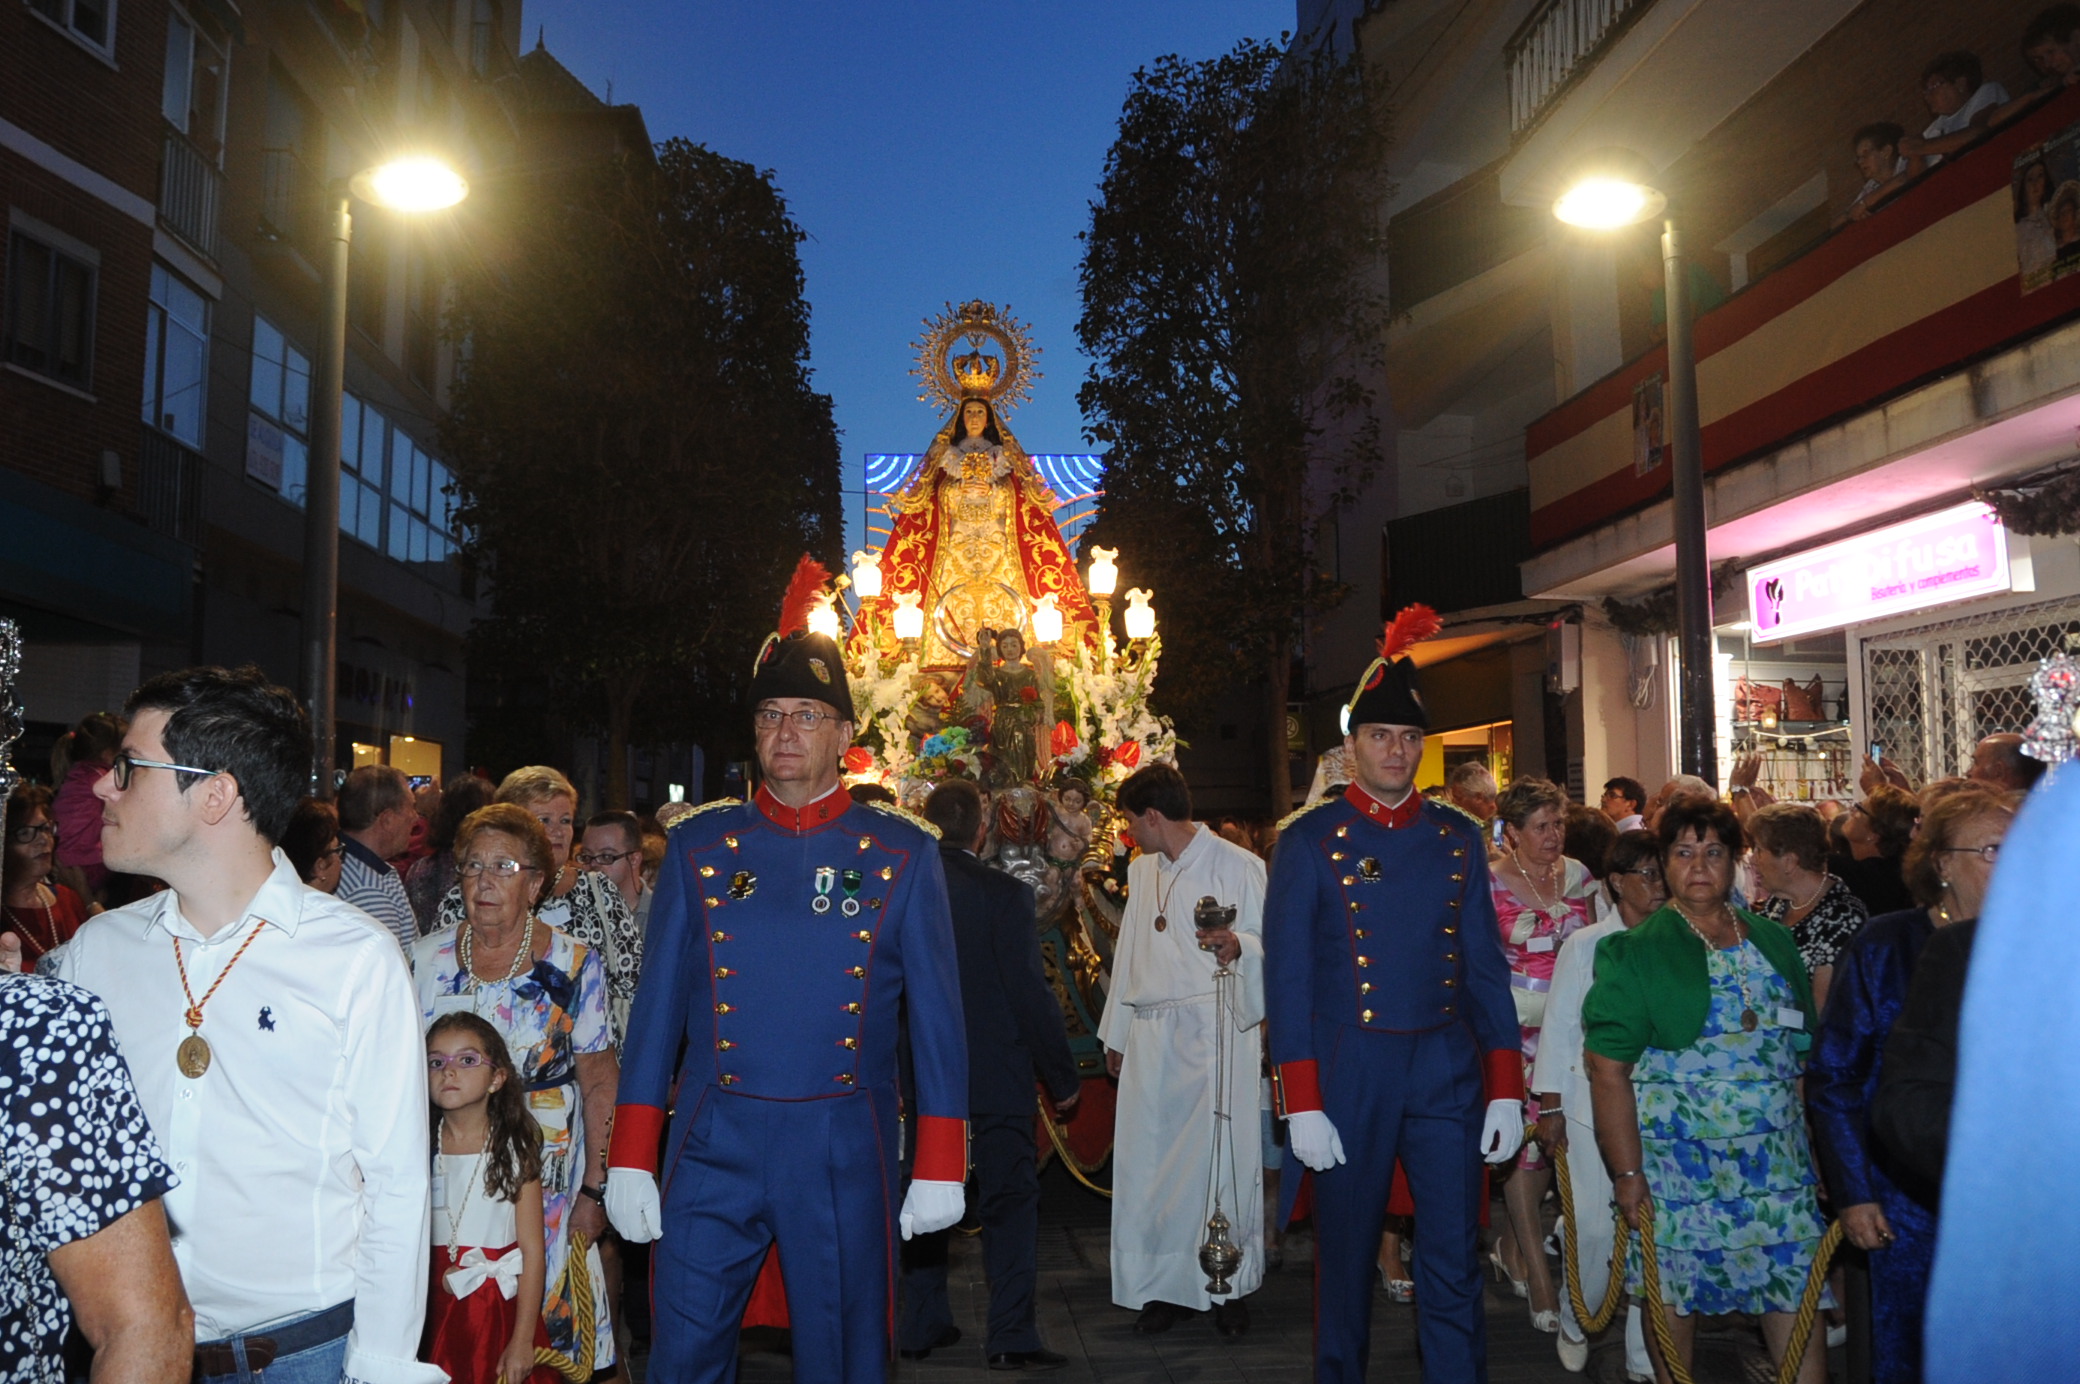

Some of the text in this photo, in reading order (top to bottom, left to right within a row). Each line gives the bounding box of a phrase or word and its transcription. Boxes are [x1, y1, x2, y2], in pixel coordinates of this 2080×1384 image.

[1795, 557, 1860, 602] Pat
[1909, 581, 1916, 595] y
[1917, 564, 1981, 590] complementos
